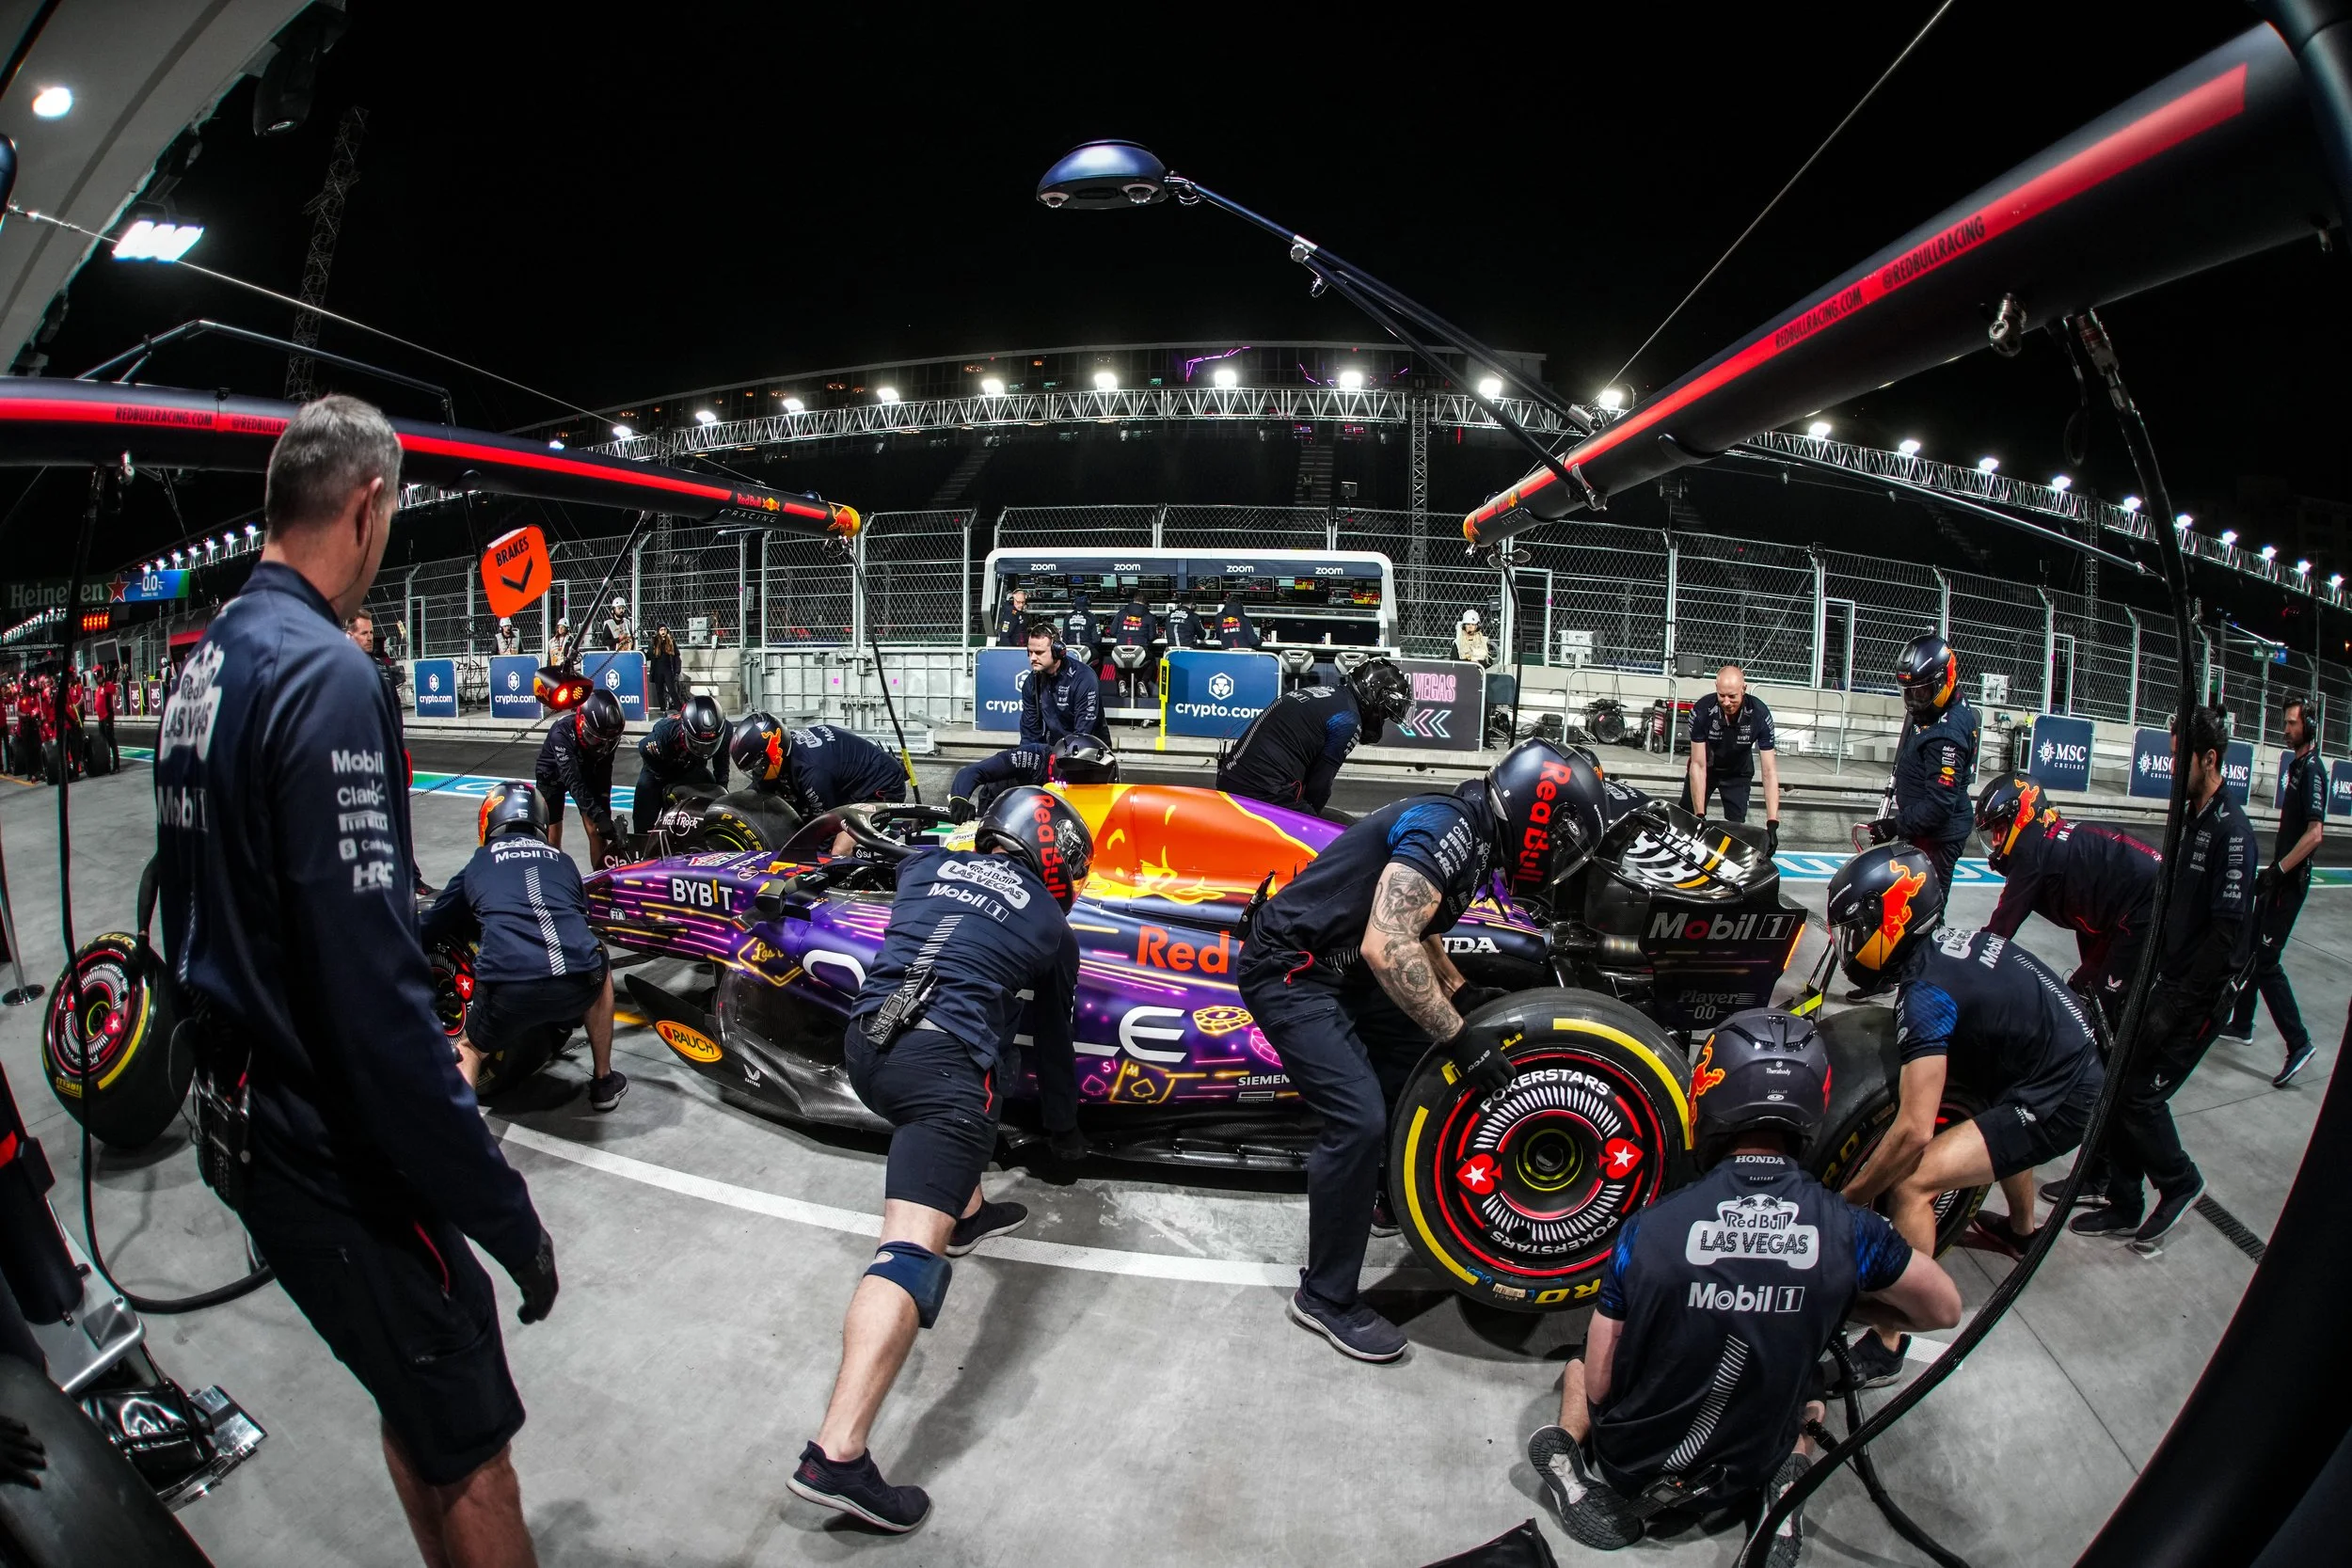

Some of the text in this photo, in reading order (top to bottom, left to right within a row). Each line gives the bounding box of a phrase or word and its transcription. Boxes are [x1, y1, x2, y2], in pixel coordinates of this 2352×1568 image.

[1883, 215, 1986, 290] @REDBULLRACING
[1775, 287, 1863, 350] REDBULLRACING.COM
[116, 406, 213, 426] REDBULLRACING.COM
[732, 511, 777, 523] RACING
[495, 535, 530, 568] BRAKES
[1030, 563, 1057, 572] zoom
[1114, 563, 1141, 572] zoom
[1226, 564, 1254, 574] zoom
[1315, 566, 1343, 576] zoom
[1412, 672, 1456, 704] VEGAS
[419, 694, 453, 705] crypto.com
[495, 693, 536, 705] crypto.com
[985, 699, 1024, 714] crypt
[2055, 743, 2087, 763] MSC
[2054, 762, 2085, 770] CRUISES
[2228, 764, 2249, 780] MSC
[680, 816, 698, 829] Rock
[1029, 794, 1056, 843] Red
[1513, 760, 1572, 882] Red Bull
[734, 819, 764, 851] ZER
[495, 849, 541, 863] Mobil
[353, 862, 394, 887] HRC
[947, 864, 1025, 902] LAS VEGAS
[970, 863, 1018, 886] Red Bull
[671, 878, 734, 911] BYBIT
[927, 882, 987, 909] Mobil
[1648, 912, 1757, 940] Mobil
[751, 942, 774, 962] Las
[1136, 926, 1230, 974] Red
[1442, 937, 1501, 954] NDA
[1677, 990, 1739, 1006] Player
[1693, 1005, 1717, 1021] 0.0
[672, 1028, 715, 1055] RAUCH
[1238, 1073, 1291, 1086] SIEMEN
[1480, 1068, 1611, 1114] POKERSTARS
[1734, 1154, 1786, 1164] HONDA
[1726, 1212, 1788, 1229] Red Bull
[1699, 1229, 1809, 1255] LAS VEGAS
[1688, 1281, 1773, 1312] Mobil
